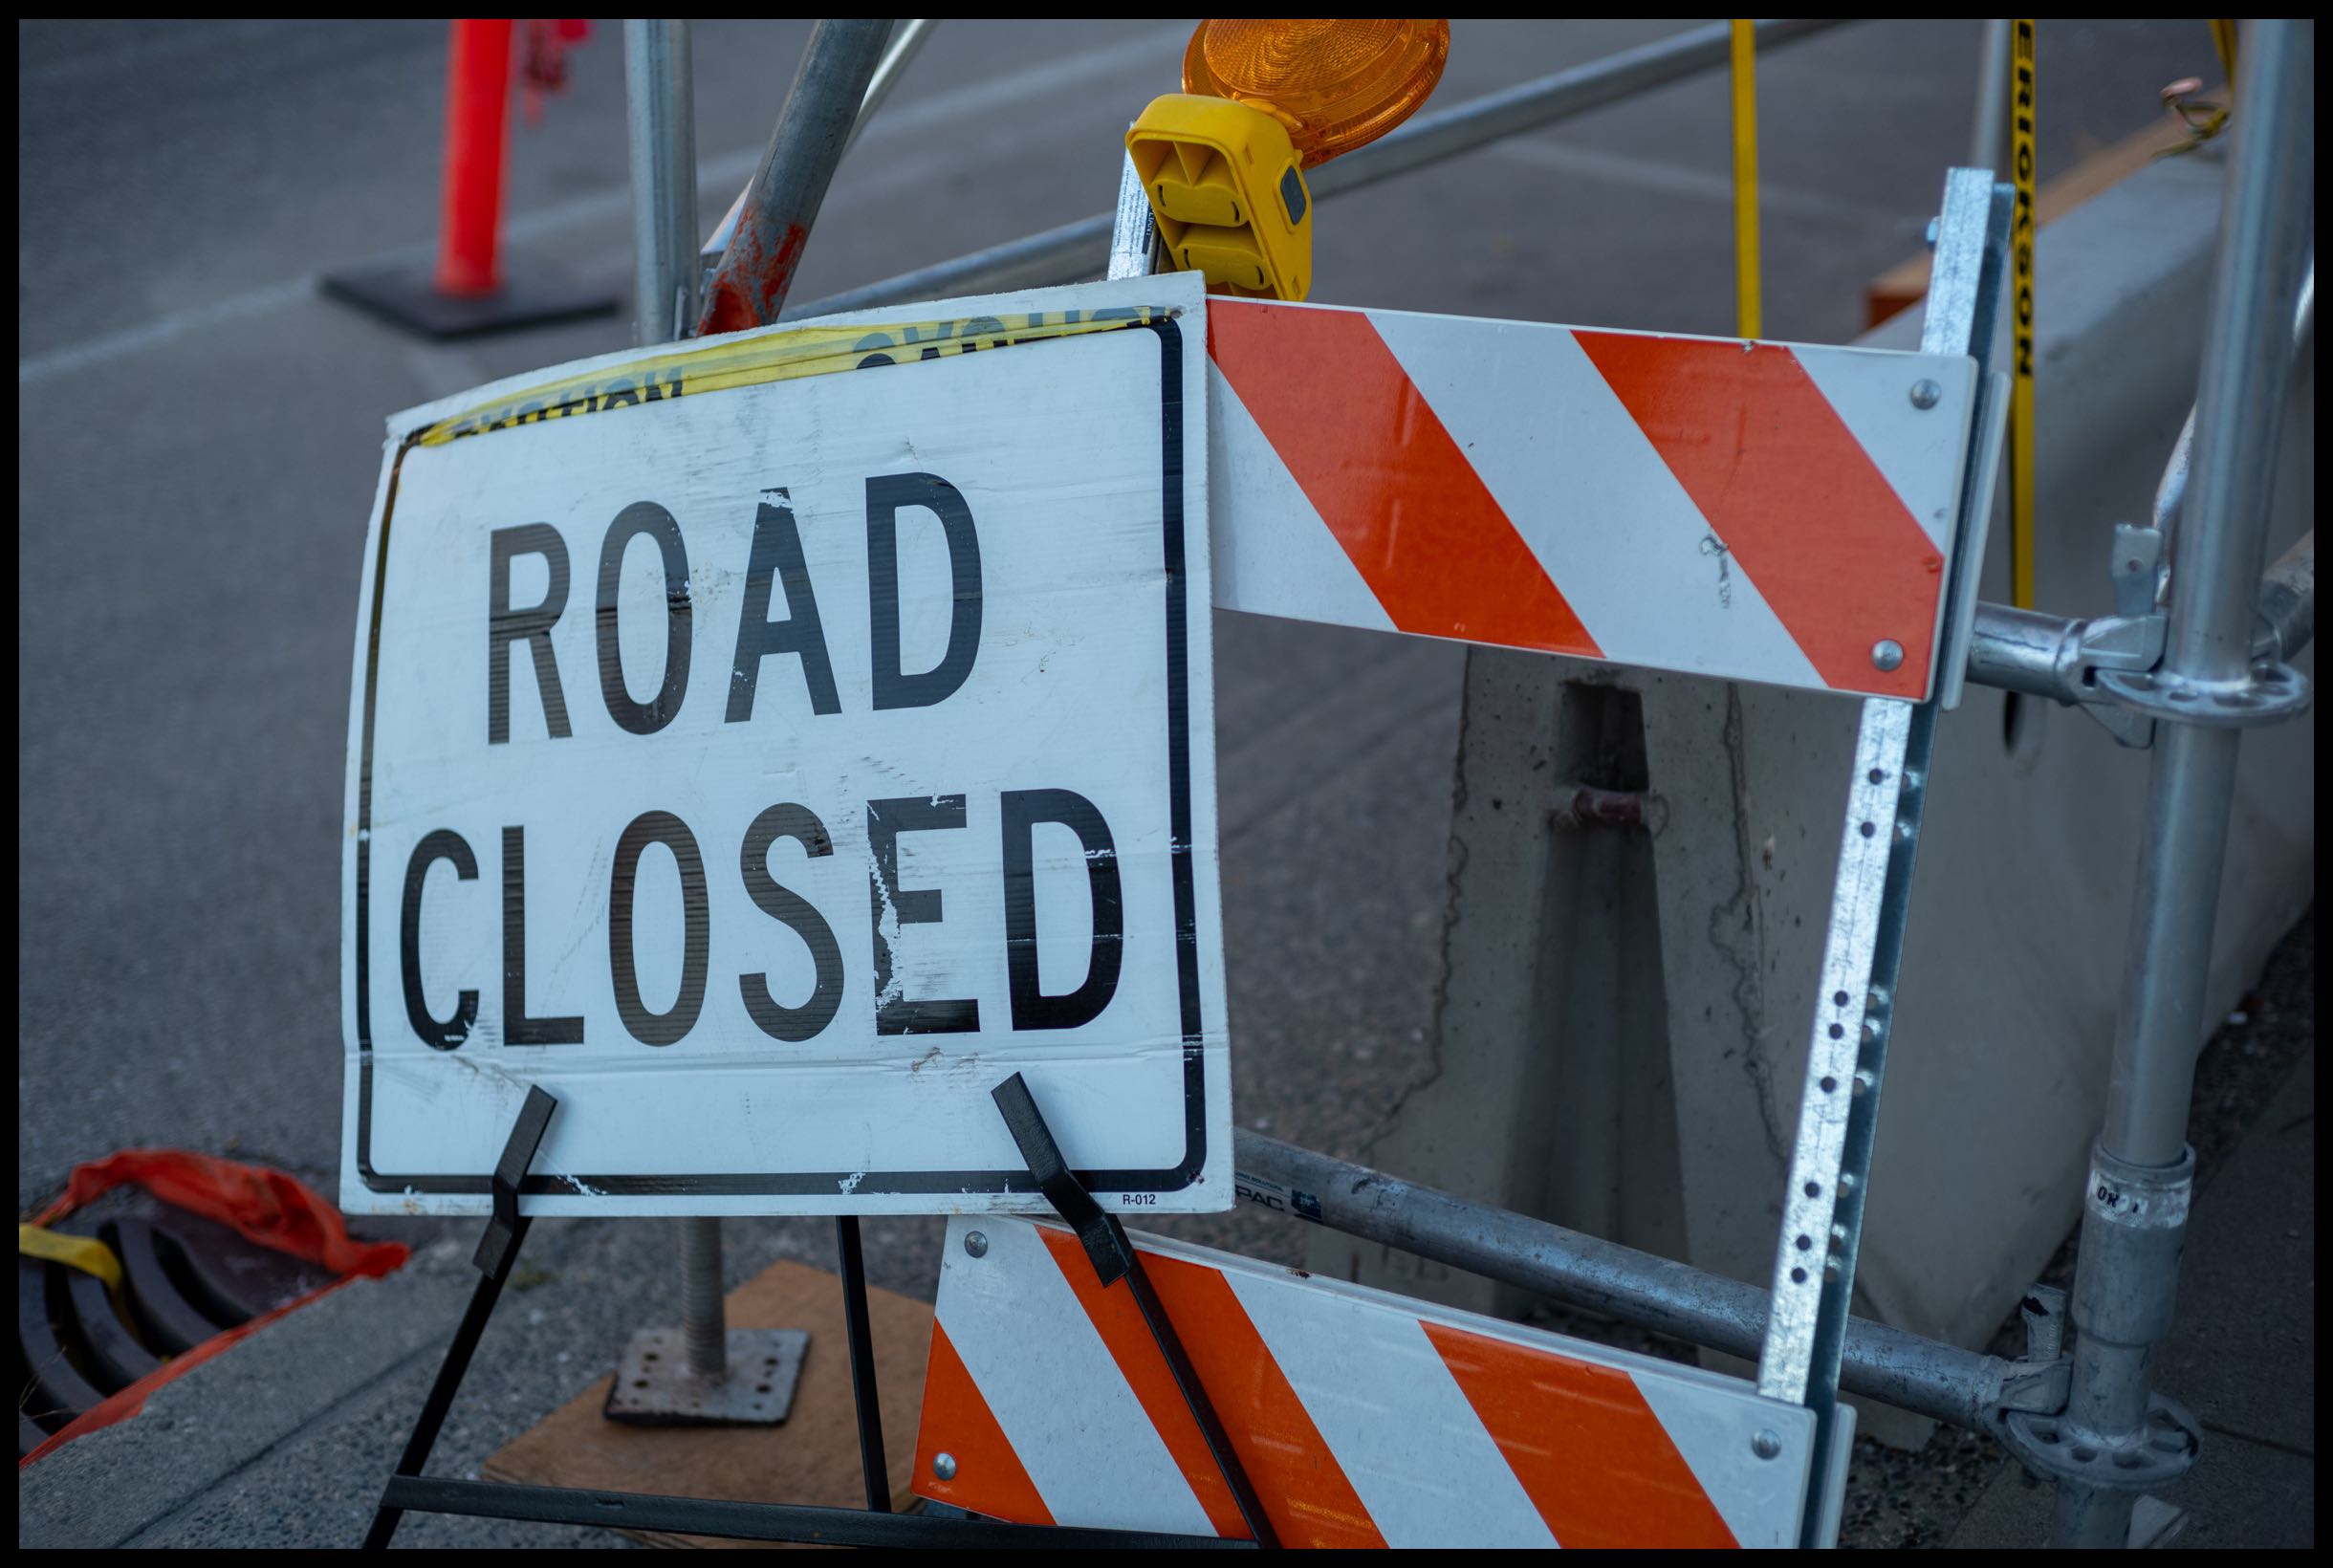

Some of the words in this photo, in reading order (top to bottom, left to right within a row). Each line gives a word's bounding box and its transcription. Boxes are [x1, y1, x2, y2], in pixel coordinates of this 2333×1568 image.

[488, 472, 984, 744] ROAD
[400, 789, 1123, 1052] CLOSED
[1123, 1194, 1156, 1205] R-012
